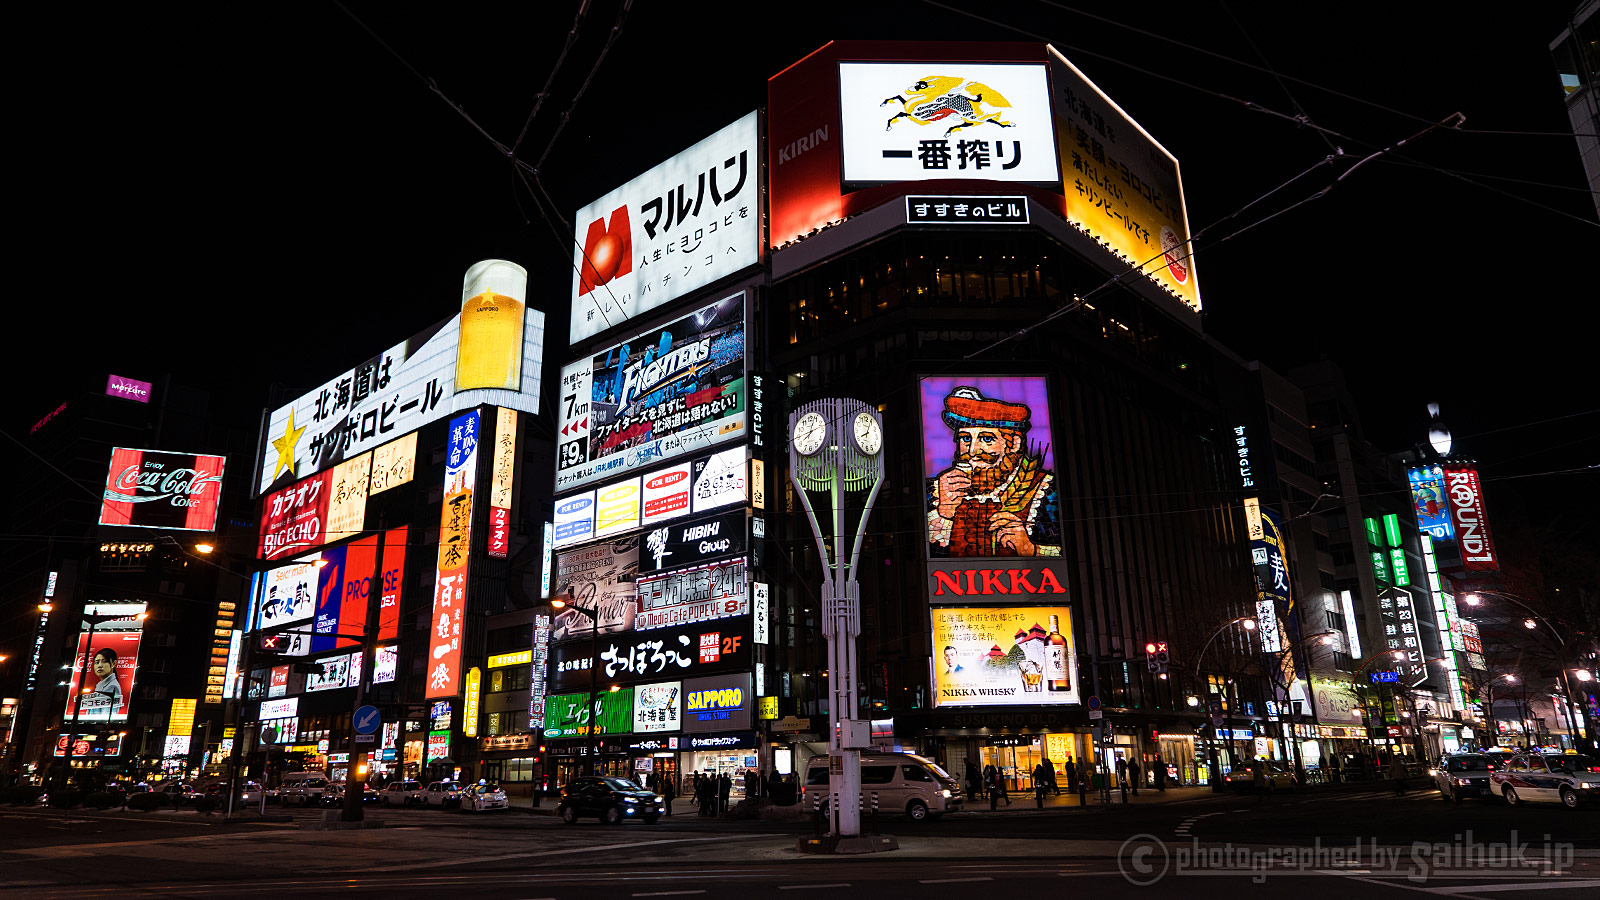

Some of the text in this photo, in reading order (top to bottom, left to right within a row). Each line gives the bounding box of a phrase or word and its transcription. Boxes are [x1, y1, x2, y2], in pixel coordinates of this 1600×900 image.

[777, 124, 830, 165] KIRIN
[881, 139, 1022, 170] 一番搾り
[640, 149, 748, 241] マルハン
[914, 203, 1021, 218] すすきのビル
[639, 205, 749, 269] 人生にヨロコビを
[586, 245, 737, 322] 新しいパチンコへ
[111, 382, 147, 396] Mercure
[312, 355, 393, 423] 北海道は
[563, 367, 592, 387] 札幌ドーム
[571, 380, 583, 391] まで
[614, 337, 712, 418] FIGHTERS
[308, 377, 444, 466] サッポロビール
[596, 397, 687, 439] ファイターズを見ずに
[450, 425, 464, 466] 革命
[1233, 425, 1254, 487] すすきのビル
[115, 465, 208, 495] Coca-Cola
[144, 460, 165, 470] Enjoy
[651, 473, 683, 488] FOR RENT!
[170, 494, 200, 508] Coke
[270, 480, 323, 519] カラオケ
[561, 505, 571, 513] FOR
[264, 529, 287, 556] BIG
[284, 516, 320, 543] ECHO
[492, 508, 506, 551] カラオケ
[682, 521, 721, 543] HIBIKI
[699, 537, 730, 554] Group
[275, 563, 309, 582] Seicmart
[346, 568, 399, 603] PROSE
[454, 572, 464, 600] 本格
[931, 567, 1067, 597] NIKKA
[646, 598, 745, 626] Media Cafe POPEYE 8F
[430, 575, 456, 692] 百姓一揆
[722, 635, 742, 655] 2F
[1395, 595, 1423, 676] 第23桂和ビル
[497, 652, 528, 665] すすきの交番
[600, 634, 692, 678] さっぽろっこ
[687, 687, 743, 711] SAPPORO
[942, 687, 1017, 697] NIKKA WHISKY
[467, 682, 479, 735] すすきの交番
[698, 710, 731, 721] DRUG STORE
[952, 713, 1062, 726] SUSUKINO BLD.
